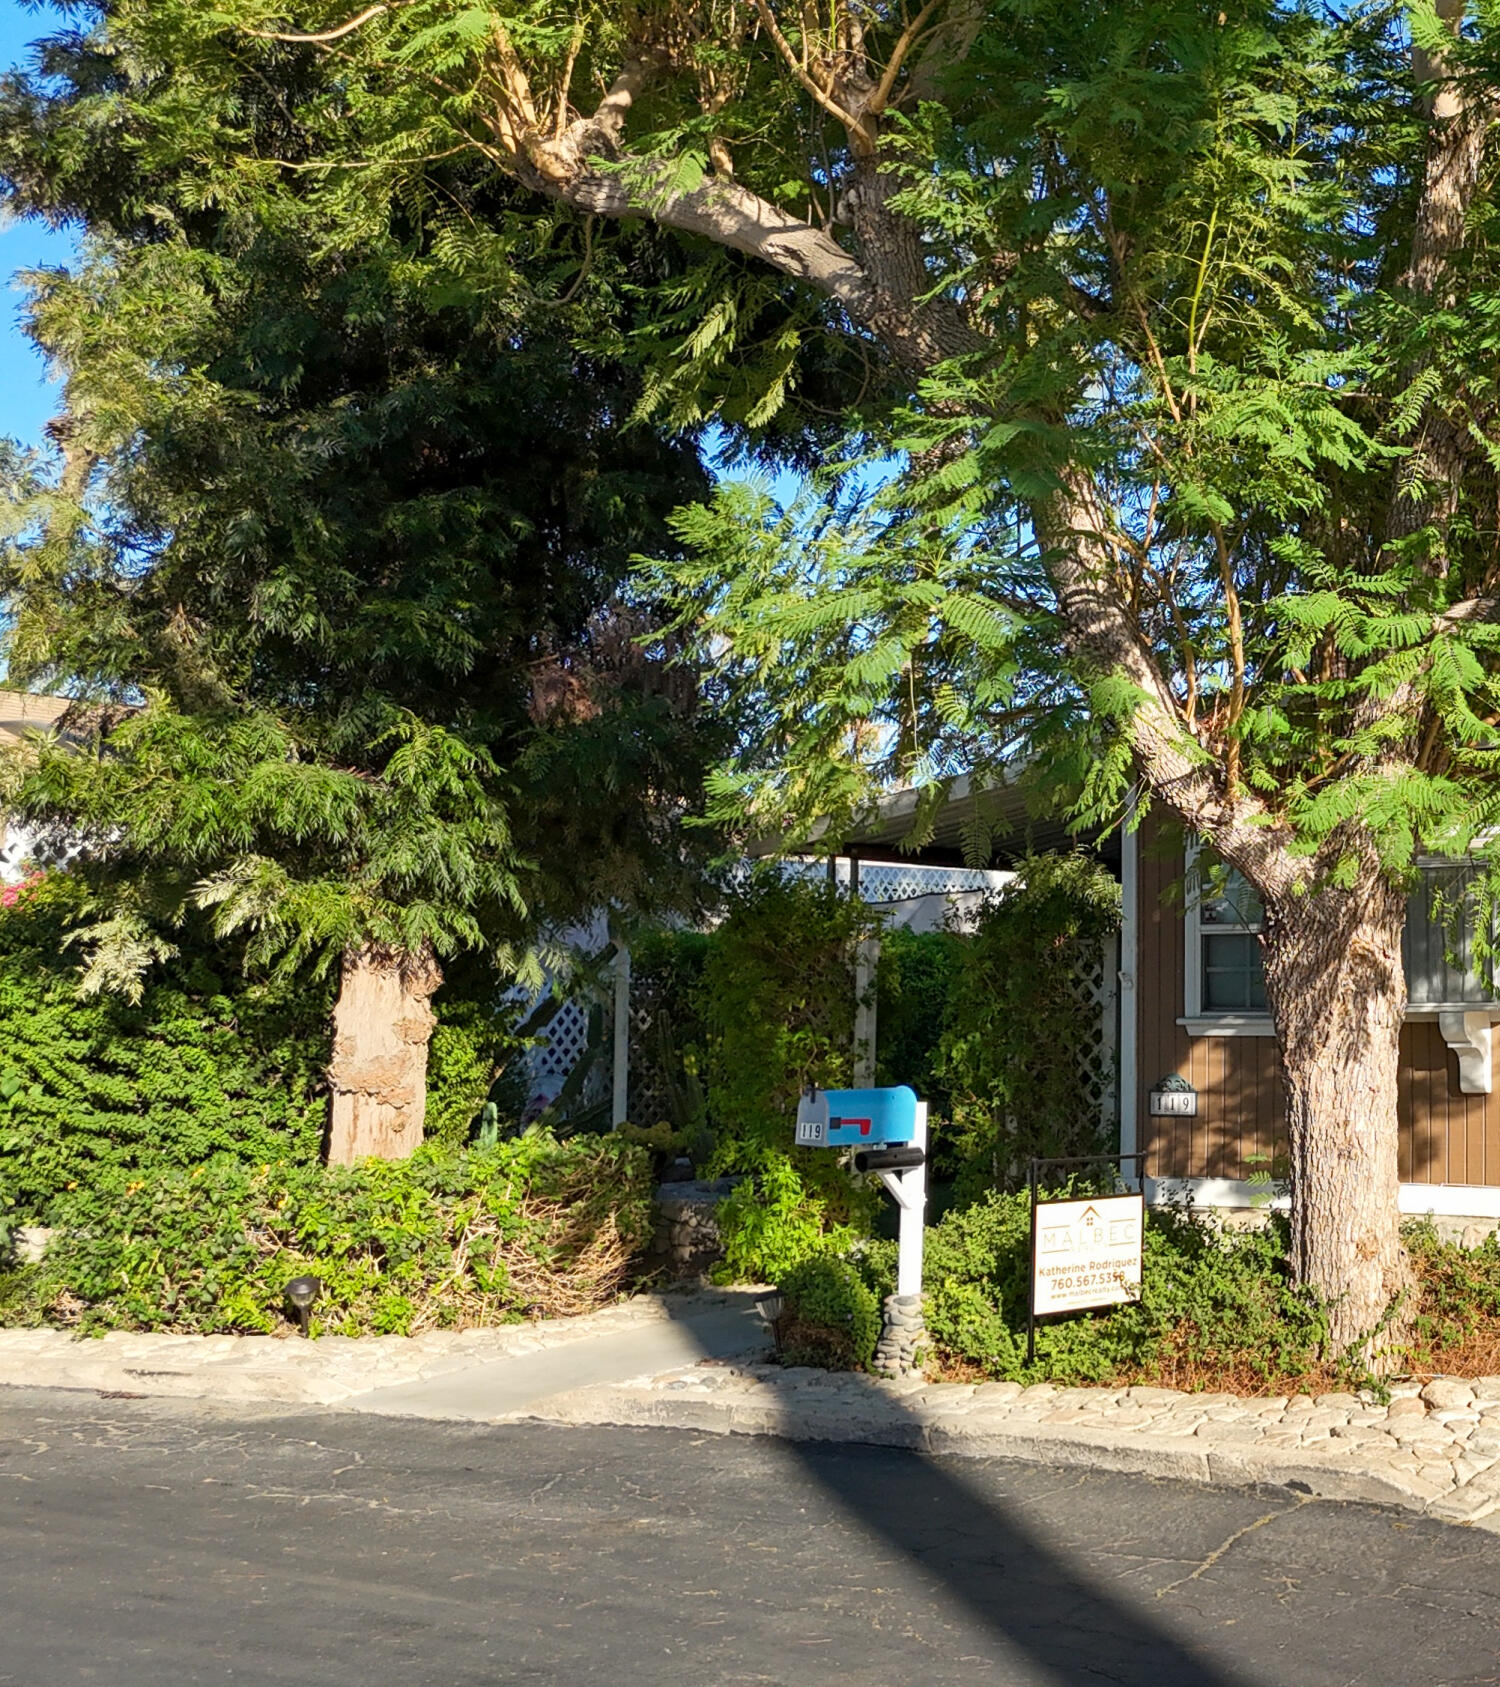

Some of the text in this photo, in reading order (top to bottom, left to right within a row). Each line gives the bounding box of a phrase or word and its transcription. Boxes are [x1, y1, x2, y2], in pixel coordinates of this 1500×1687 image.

[1157, 1096, 1190, 1112] 119
[802, 1123, 822, 1139] 119
[1042, 1223, 1136, 1249] MALBEC
[1038, 1263, 1087, 1278] Katherine
